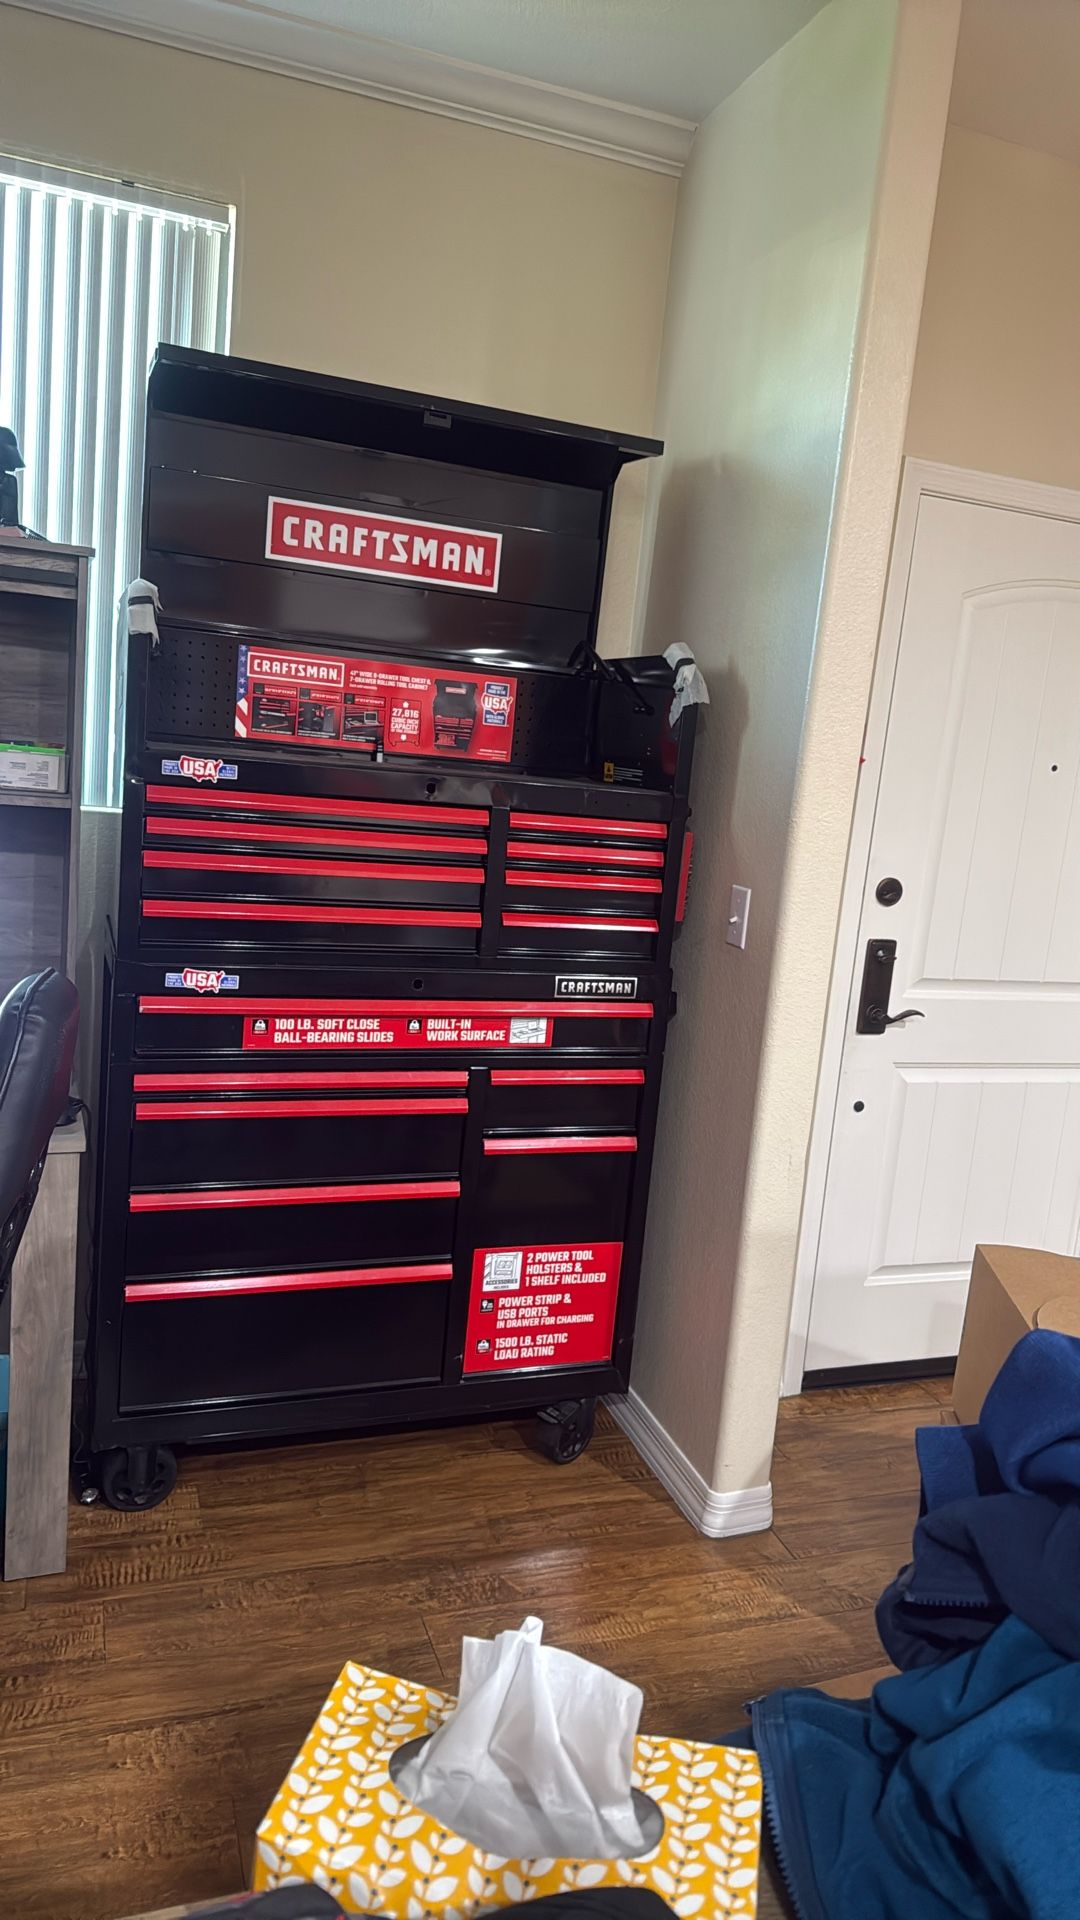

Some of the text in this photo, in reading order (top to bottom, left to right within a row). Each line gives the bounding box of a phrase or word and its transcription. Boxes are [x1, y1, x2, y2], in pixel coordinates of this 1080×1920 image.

[282, 515, 485, 576] CRAFTSMAN
[253, 658, 338, 681] CRAFTSMAN
[377, 679, 396, 687] ROLLING
[400, 675, 410, 683] TOOL
[411, 676, 426, 685] CHEST
[484, 696, 508, 710] USA
[390, 722, 419, 732] CAPACITY
[391, 717, 420, 727] CUBIC INCH
[183, 760, 216, 777] USA
[186, 973, 218, 987] USA
[561, 981, 632, 994] CRAFTSMAN
[274, 1018, 380, 1030] 100 LB. SOFT CLOSE
[427, 1018, 472, 1030] BUILT-IN
[274, 1031, 394, 1044] BALL-BEARING SLIDES
[426, 1030, 506, 1042] WORK SURFACE
[527, 1250, 594, 1263] 2 POWER TOOL
[526, 1262, 582, 1275] HOLSTERS &
[525, 1272, 606, 1287] 1 SHELF INCLUDED
[498, 1293, 572, 1308] POWER STRIP &
[498, 1306, 549, 1320] USB PORTS
[496, 1314, 594, 1329] IN DRAWER FOR CHARGING
[495, 1333, 568, 1348] 1500 LB. STATIC
[494, 1346, 555, 1360] LOAD RATING
